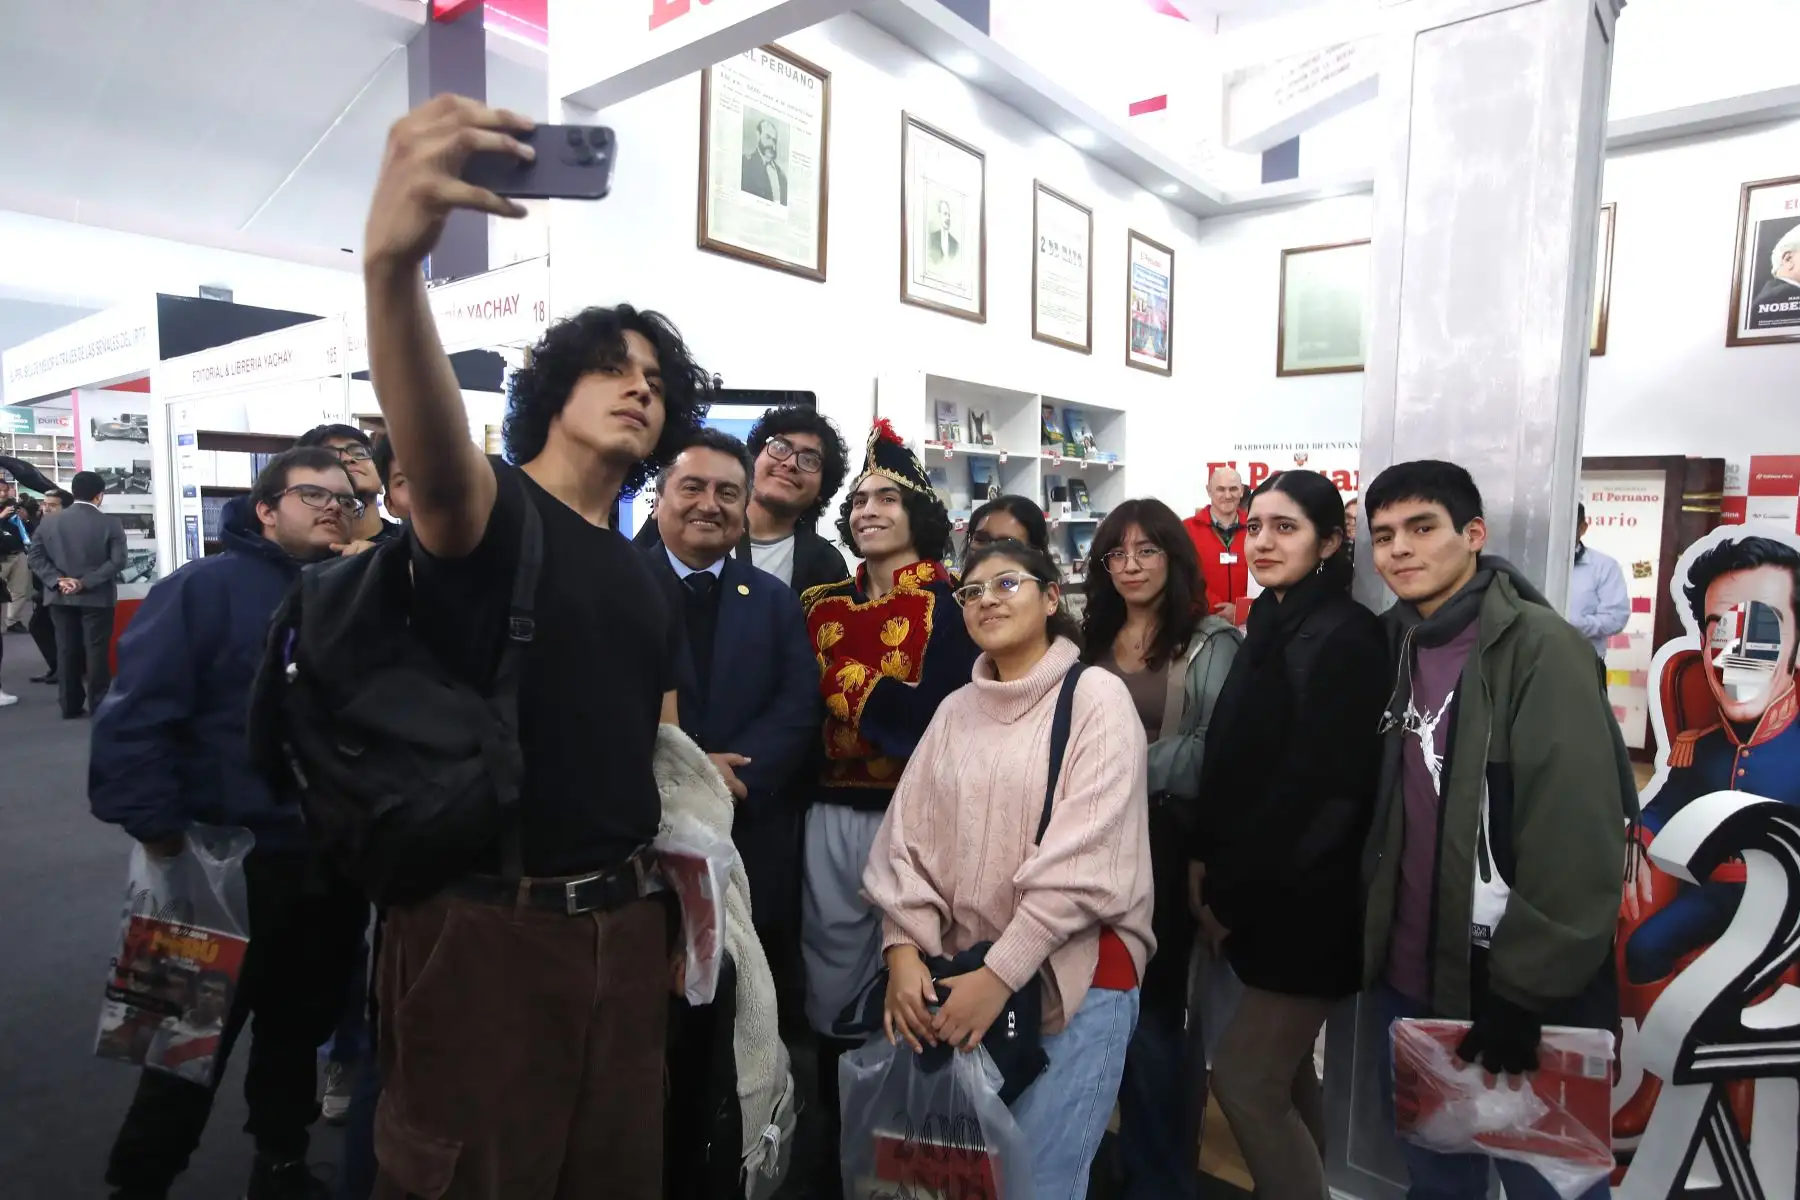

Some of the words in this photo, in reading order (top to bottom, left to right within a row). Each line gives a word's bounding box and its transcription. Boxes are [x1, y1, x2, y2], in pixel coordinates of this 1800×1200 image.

[761, 54, 814, 90] PERUANO
[467, 294, 520, 320] YACHAY
[192, 365, 224, 383] EDITORIAL
[264, 350, 293, 368] YACHAY
[1234, 443, 1262, 451] DIARIO
[1592, 492, 1603, 502] El
[1606, 492, 1659, 502] Peruano
